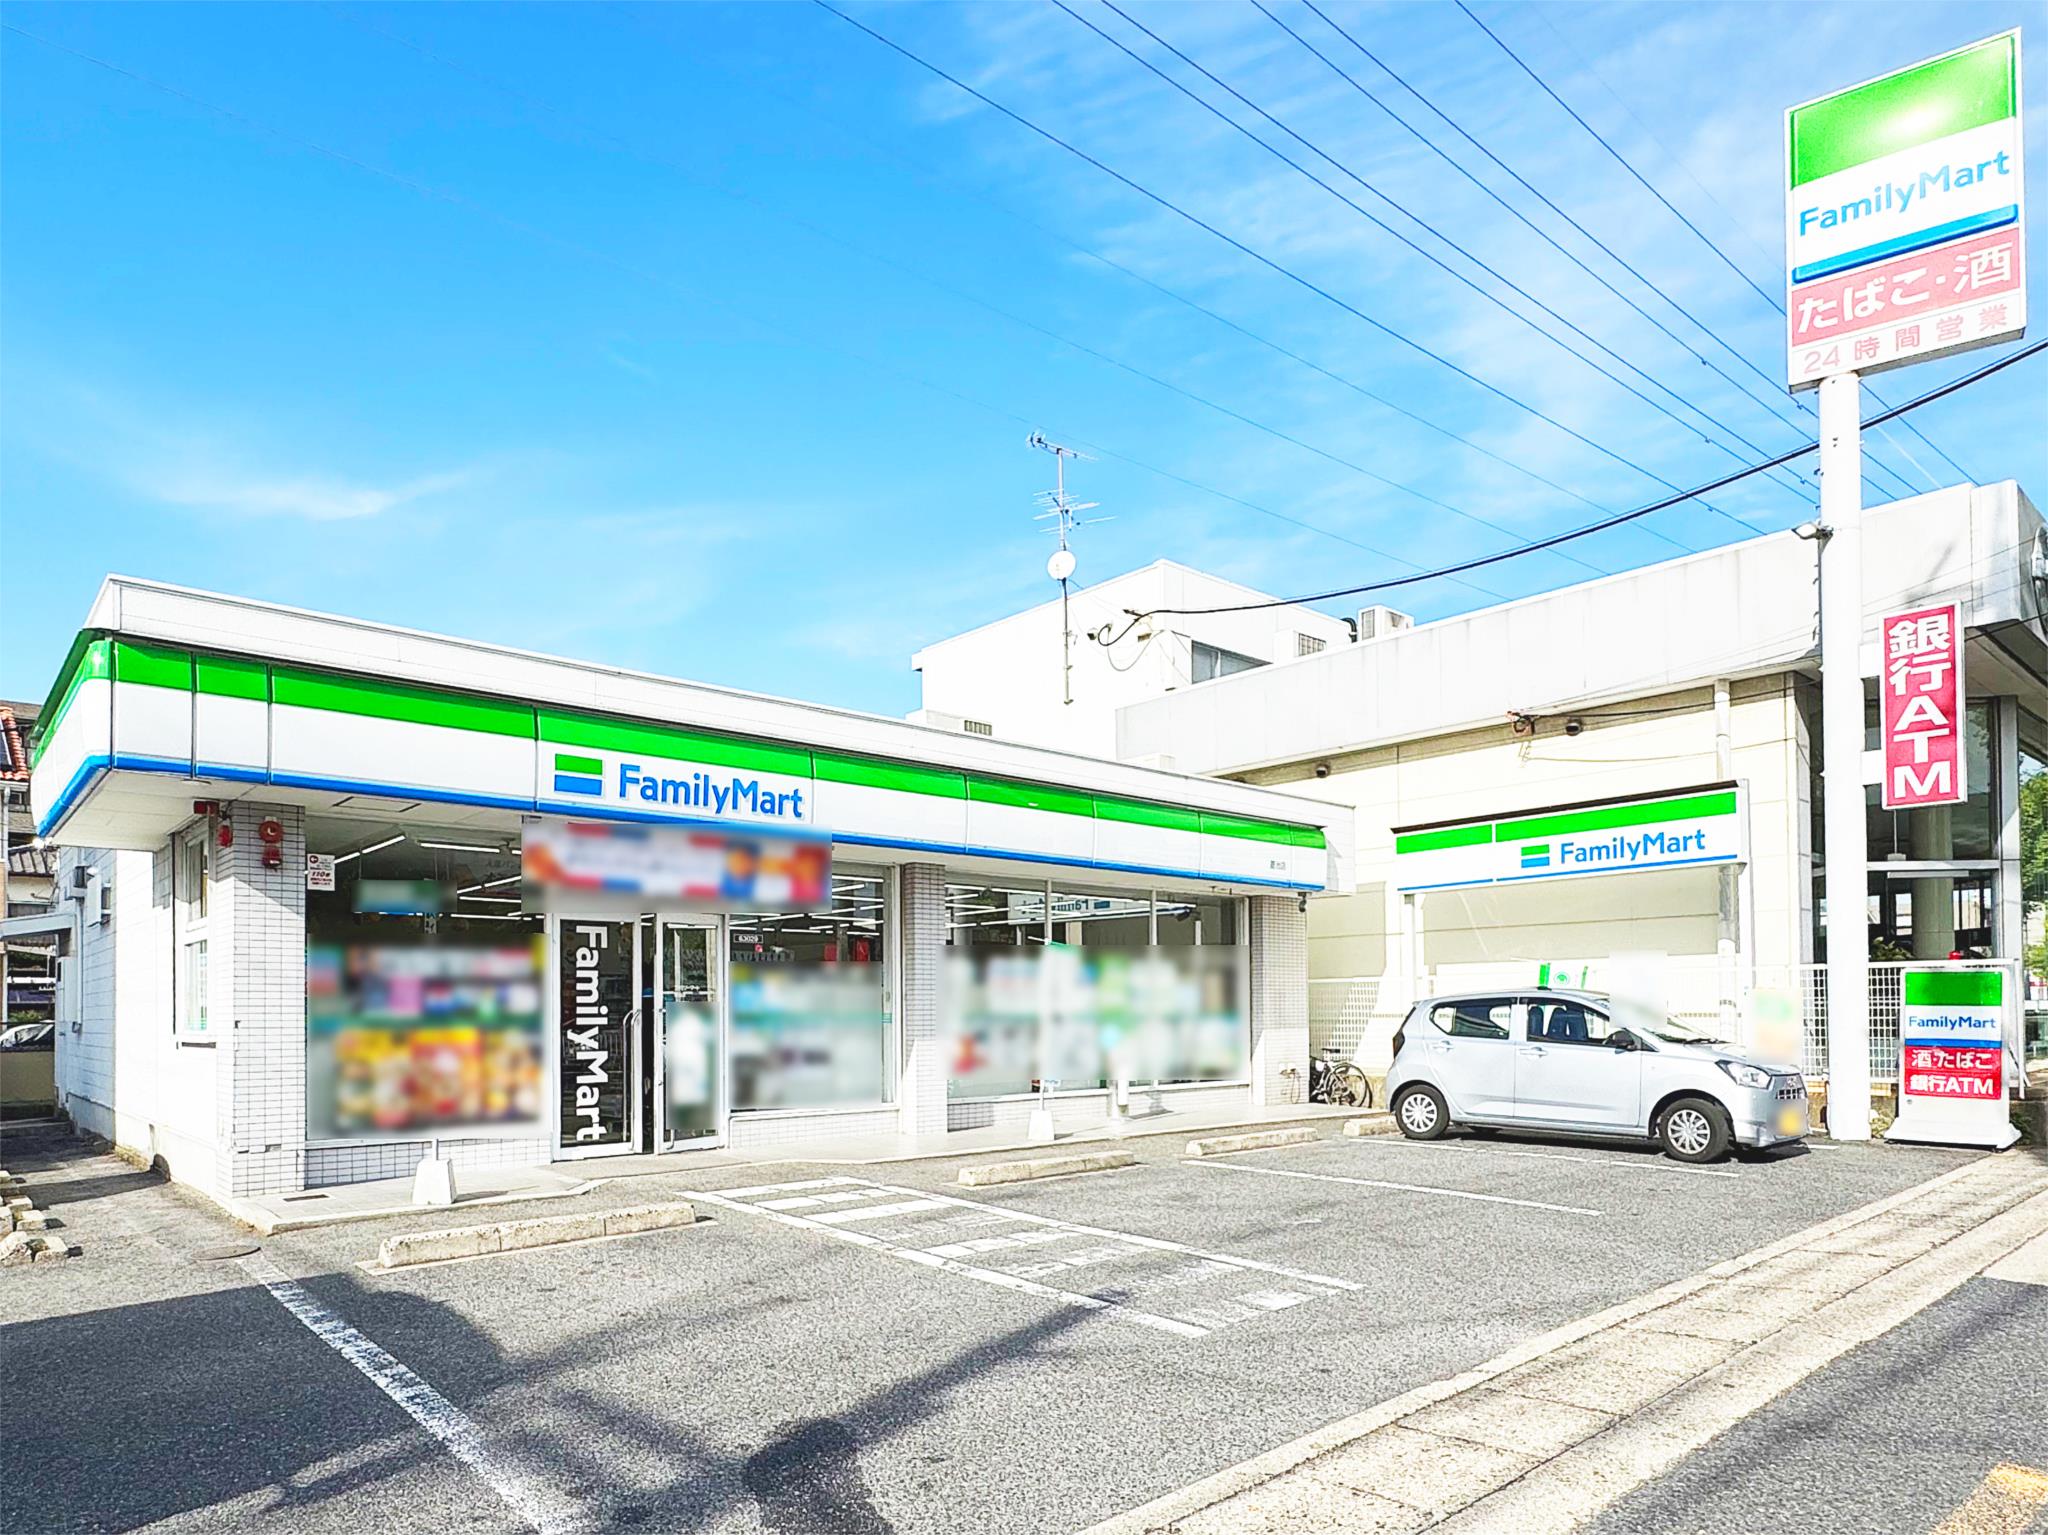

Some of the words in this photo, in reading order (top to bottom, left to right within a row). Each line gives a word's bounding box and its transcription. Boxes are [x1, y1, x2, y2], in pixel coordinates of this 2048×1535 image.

[1799, 151, 2010, 236] FamilyMart
[1798, 242, 2013, 333] たばこ・酒
[1804, 304, 2007, 374] 24時間営業
[1888, 613, 1952, 799] 銀行ATM
[619, 763, 803, 818] FamilyMart
[1561, 829, 1706, 864] FamilyMart
[567, 925, 608, 1142] FamilyMart
[1909, 1016, 1996, 1030] FamilyMart
[1909, 1074, 1994, 1094] 銀行ATM
